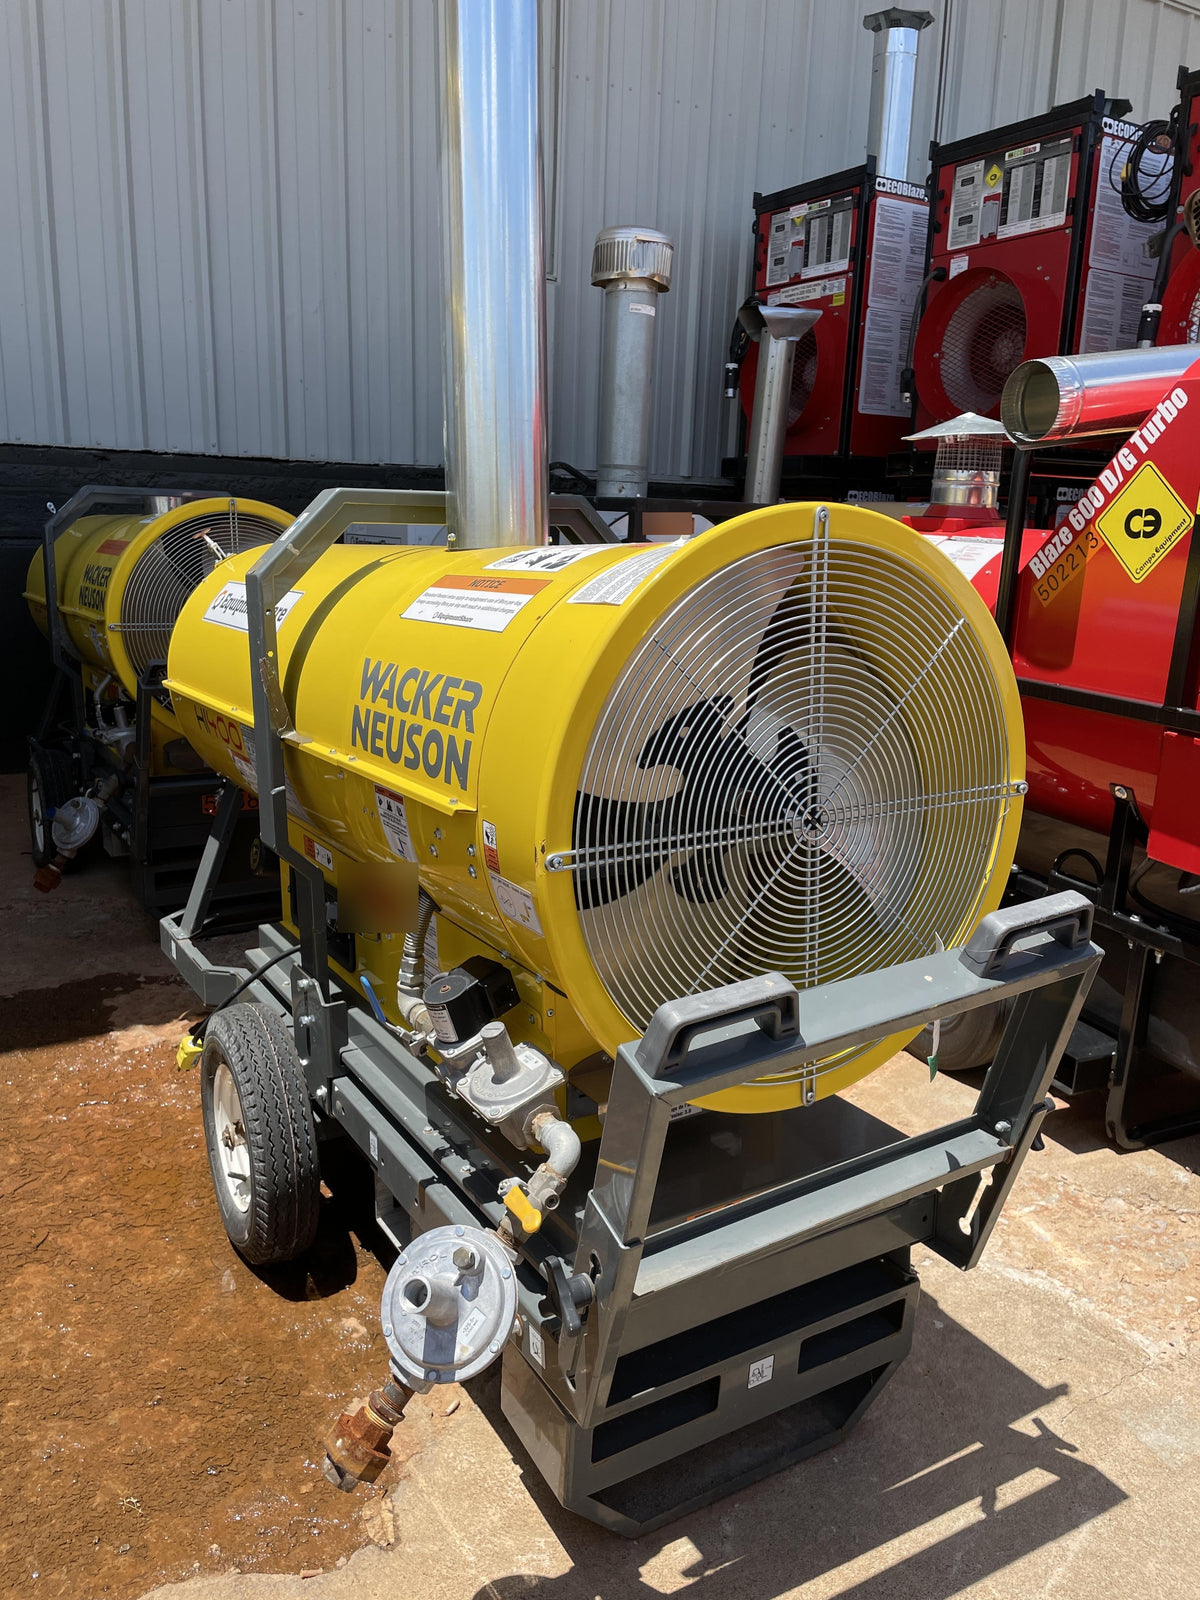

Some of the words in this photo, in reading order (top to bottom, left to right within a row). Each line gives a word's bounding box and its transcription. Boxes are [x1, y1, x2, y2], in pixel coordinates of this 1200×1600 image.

[887, 179, 925, 199] ECOBlaze
[1027, 526, 1073, 580] Blaze
[1068, 485, 1105, 531] 600
[1099, 447, 1138, 494] D/G
[1130, 387, 1189, 453] Turbo
[1135, 551, 1156, 575] Campo
[1155, 518, 1187, 554] Equipment
[83, 563, 112, 588] WACKER
[469, 579, 506, 589] NOTICE
[79, 585, 106, 613] NEUSON
[360, 657, 483, 733] WACKER
[351, 704, 472, 791] NEUSON
